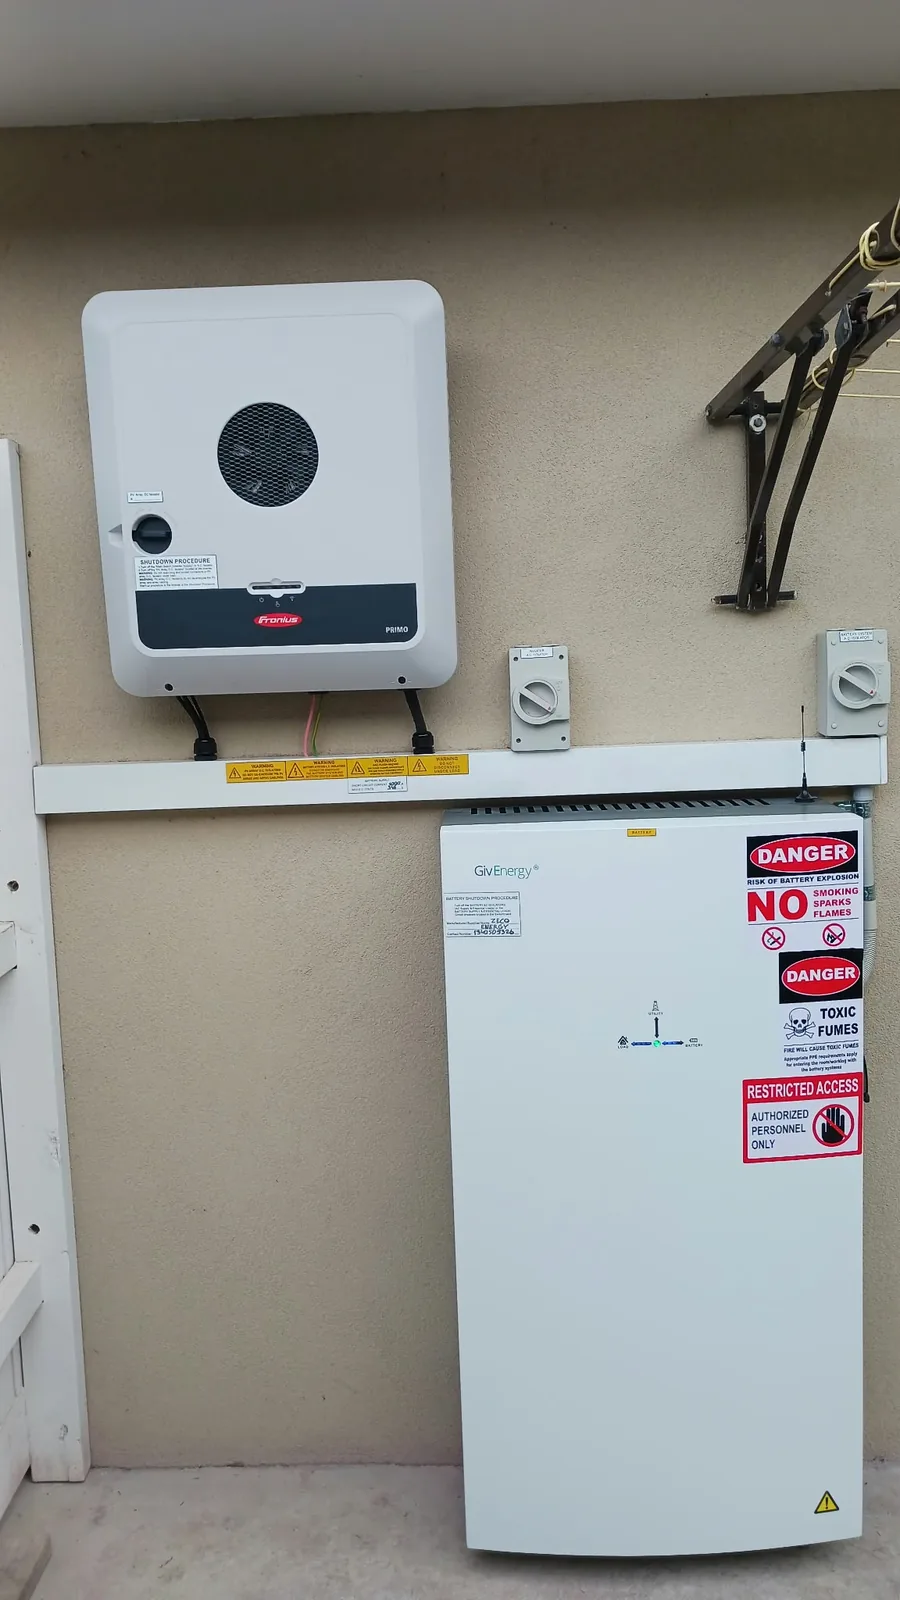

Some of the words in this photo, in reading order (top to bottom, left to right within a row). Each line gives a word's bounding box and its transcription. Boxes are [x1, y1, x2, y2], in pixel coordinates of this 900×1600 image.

[258, 616, 298, 624] Fronius
[758, 844, 848, 864] DANGER
[817, 873, 859, 881] EXPLOSION
[813, 888, 858, 896] SMOKING
[748, 889, 808, 922] NO
[814, 898, 851, 907] SPARKS
[814, 909, 851, 918] FLAMES
[787, 966, 856, 982] DANGER
[820, 1006, 856, 1019] TOXIC
[818, 1023, 858, 1037] FUMES
[748, 1082, 814, 1099] RESTRICTED
[816, 1079, 859, 1094] ACCESS
[751, 1110, 808, 1121] AUTHORIZED
[752, 1124, 806, 1135] PERSONNEL
[752, 1140, 775, 1150] ONLY
